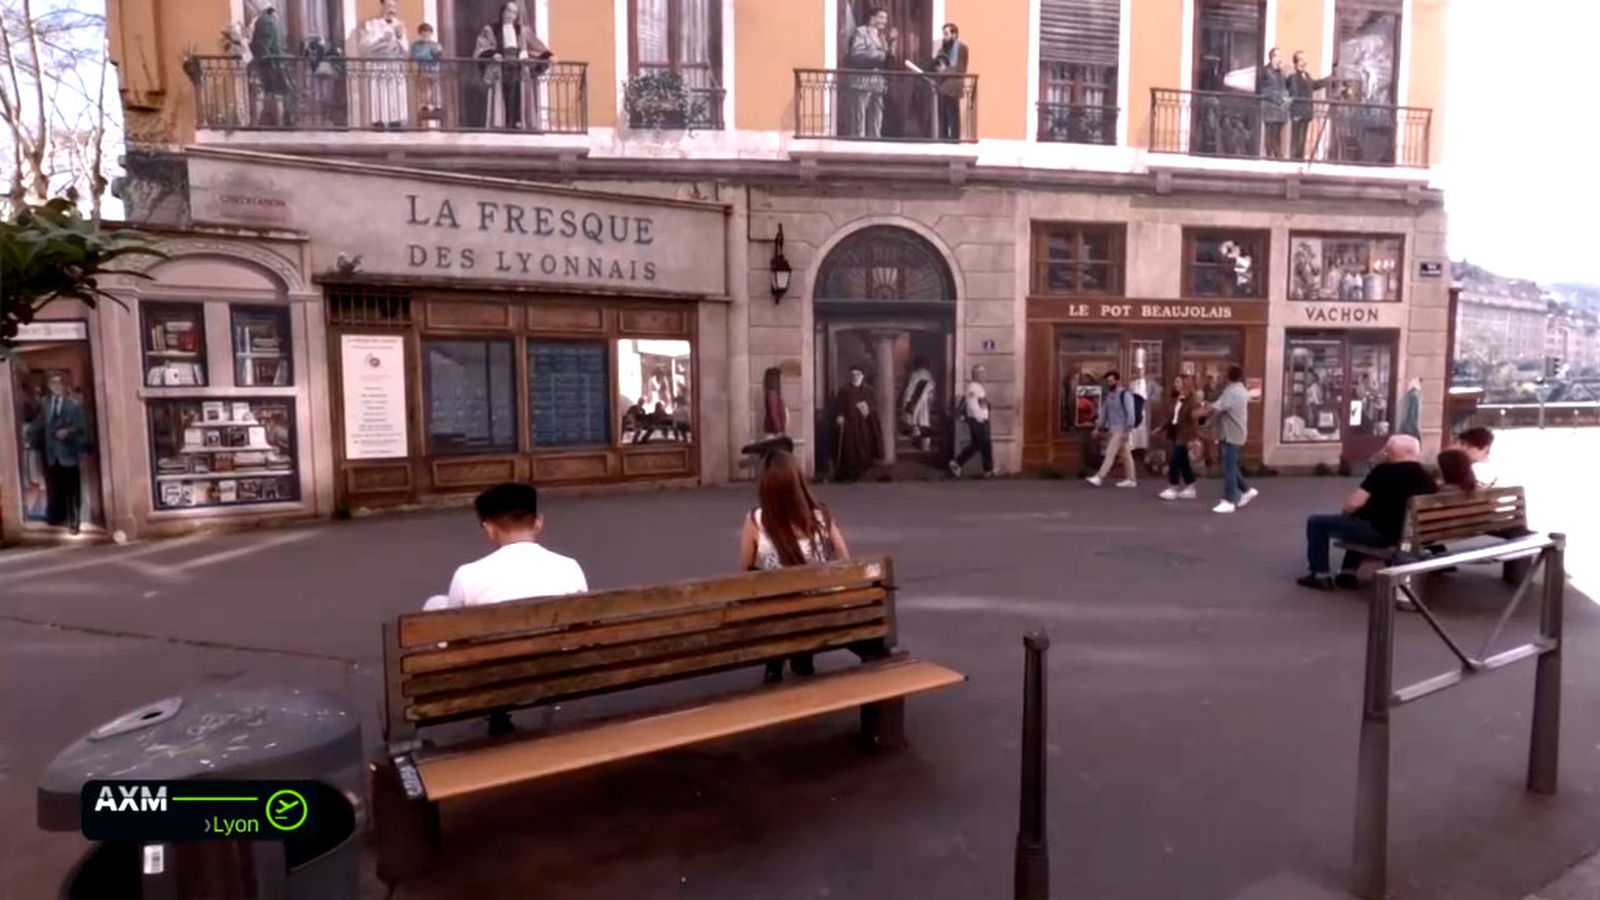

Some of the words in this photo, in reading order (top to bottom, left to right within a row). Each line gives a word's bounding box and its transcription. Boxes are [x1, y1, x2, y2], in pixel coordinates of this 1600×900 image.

[406, 195, 460, 229] LA
[477, 201, 655, 245] FRESQUE
[407, 245, 475, 269] DES
[495, 251, 657, 281] LYONNAIS
[1068, 304, 1089, 317] LE
[1100, 304, 1132, 317] POT
[1141, 304, 1232, 318] BEAUJOLAIS
[1305, 307, 1379, 322] VACHON
